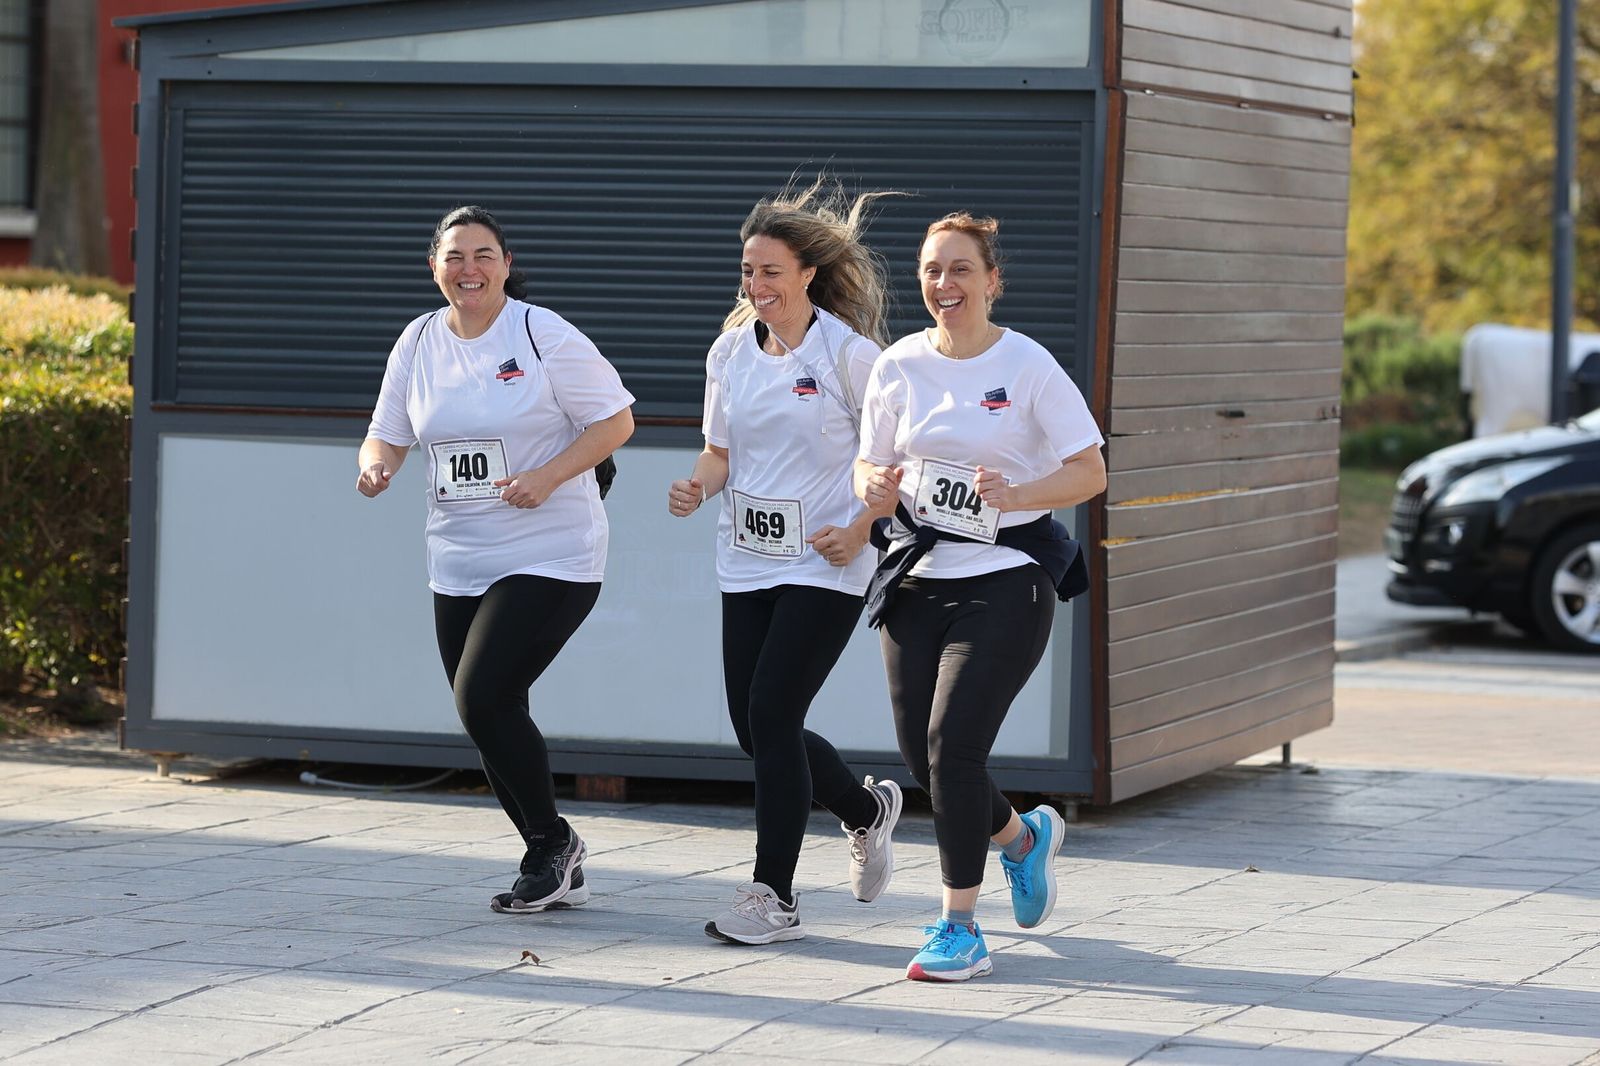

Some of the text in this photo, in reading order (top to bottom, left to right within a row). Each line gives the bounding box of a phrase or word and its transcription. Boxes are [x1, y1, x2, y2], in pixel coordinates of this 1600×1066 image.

[449, 452, 489, 482] 140
[932, 477, 982, 516] 304
[745, 507, 786, 539] 469
